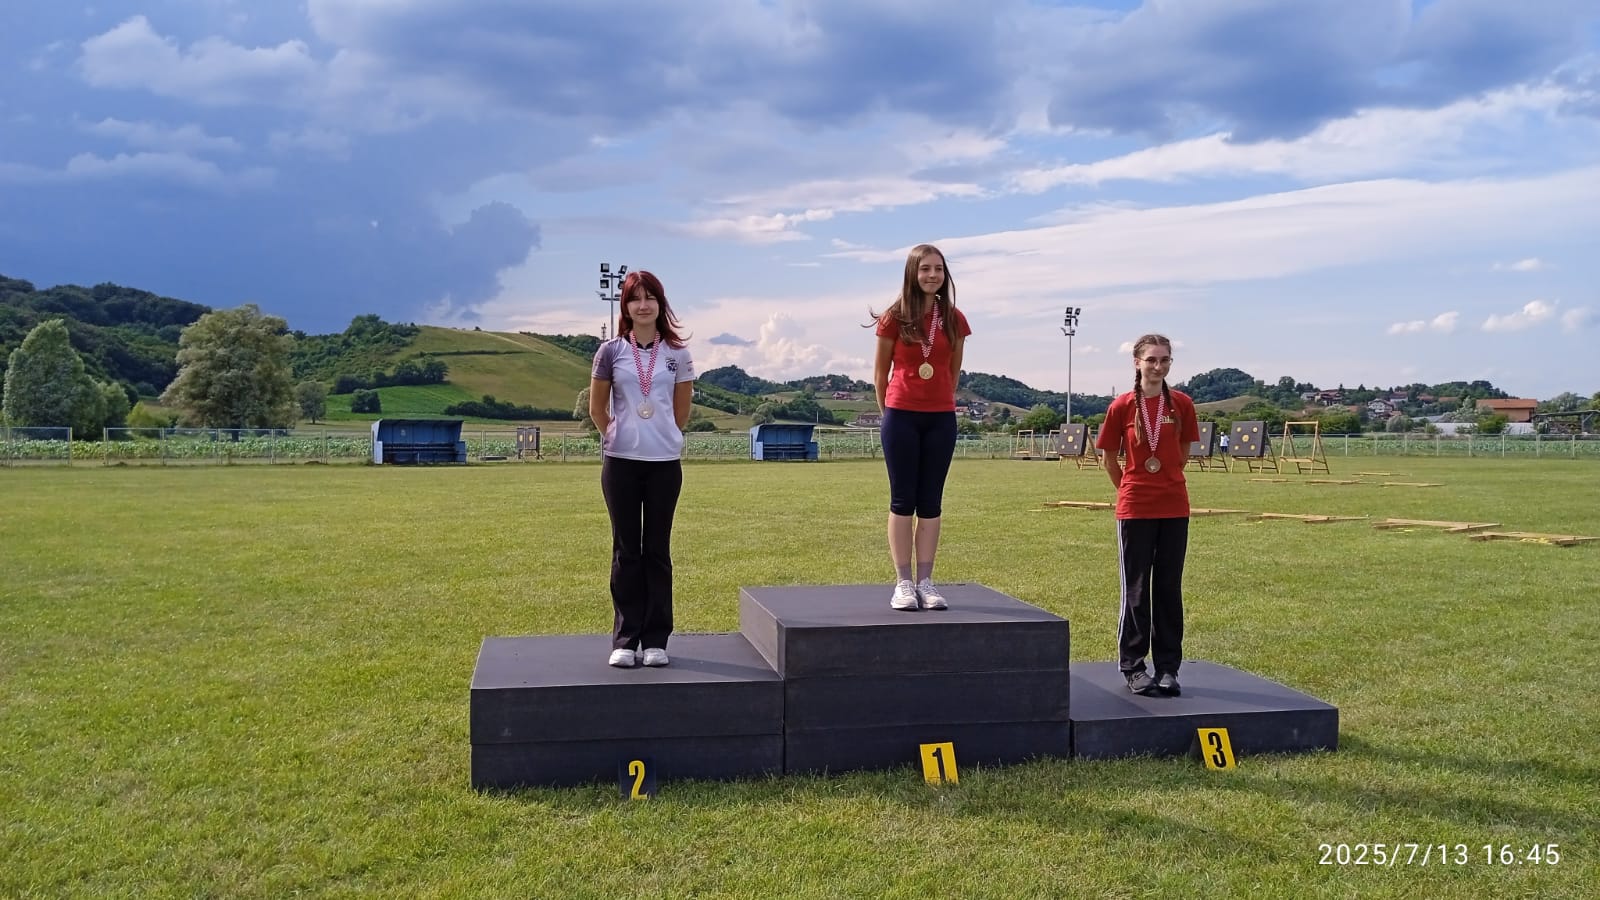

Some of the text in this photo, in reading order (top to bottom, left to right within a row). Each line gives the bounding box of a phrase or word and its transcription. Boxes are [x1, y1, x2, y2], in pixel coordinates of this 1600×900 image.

[932, 747, 945, 782] 1
[1208, 732, 1226, 767] 3
[628, 760, 647, 799] 2
